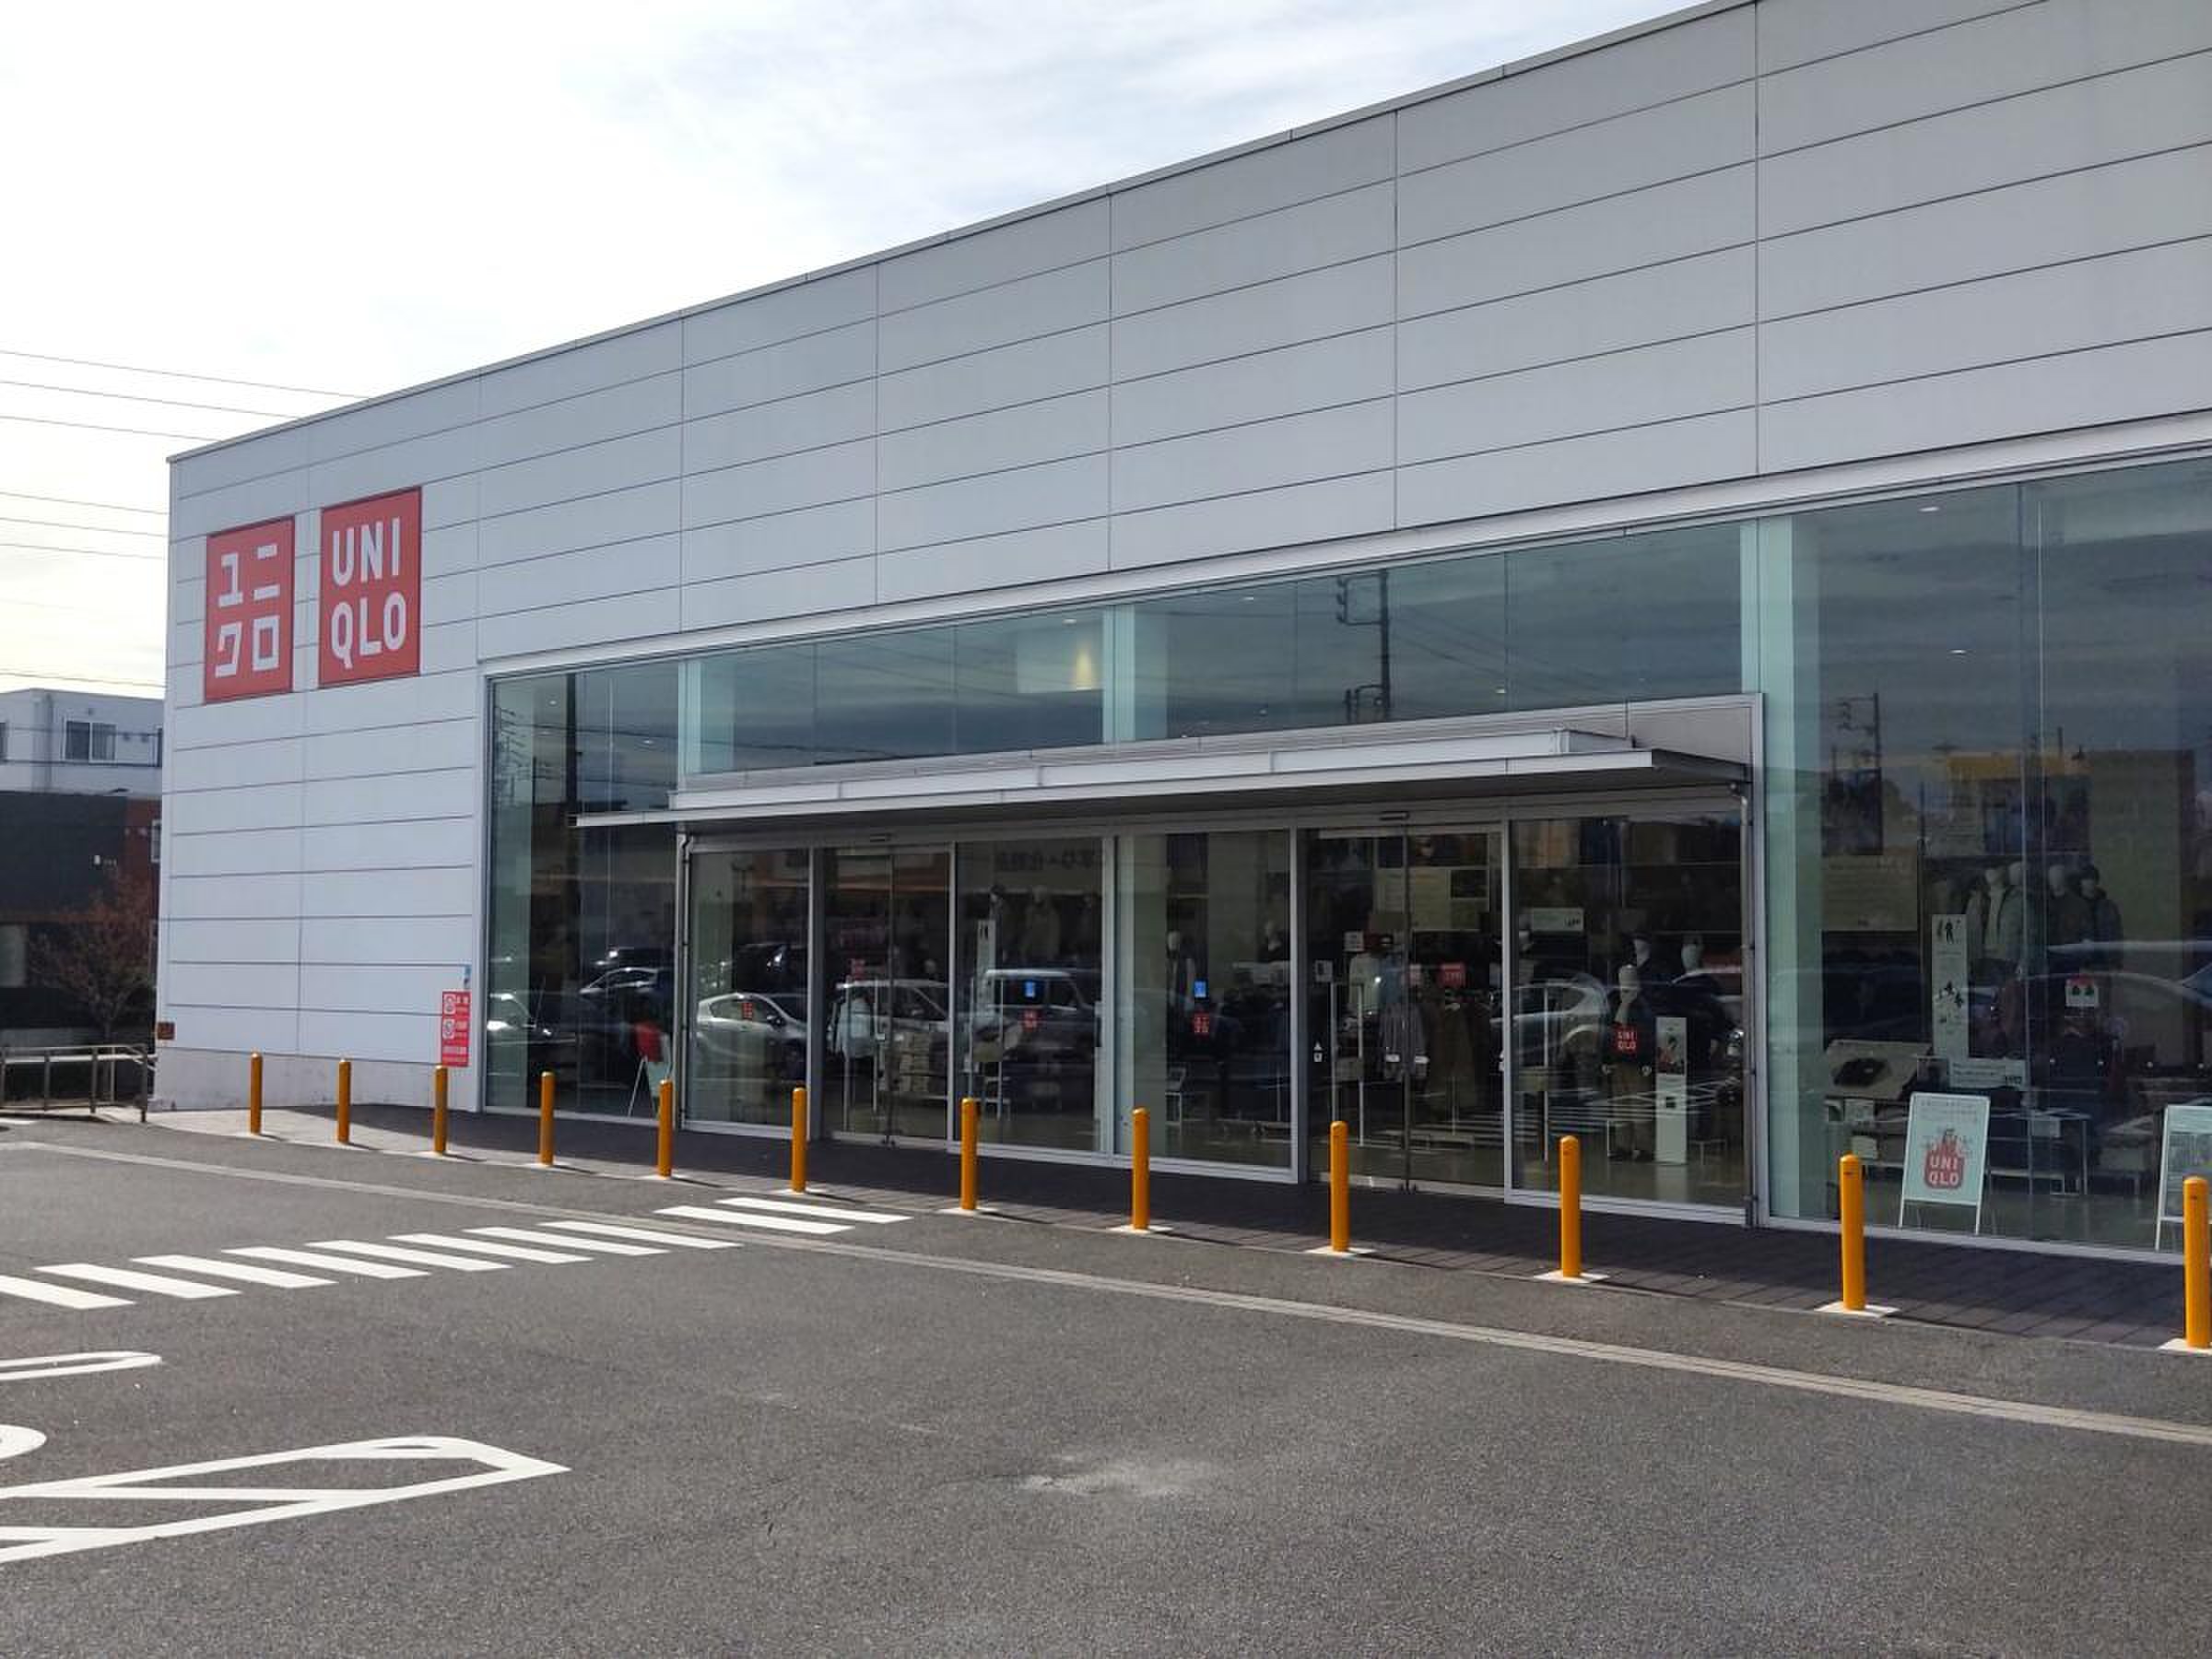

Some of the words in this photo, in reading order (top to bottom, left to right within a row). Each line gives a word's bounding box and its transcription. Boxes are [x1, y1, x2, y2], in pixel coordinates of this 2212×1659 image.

[218, 543, 280, 608] ユニ
[332, 516, 401, 586] UNI
[215, 615, 280, 678] クロ
[330, 591, 407, 670] QLO
[1928, 1171, 1959, 1186] QLO
[1929, 1155, 1958, 1171] UNI
